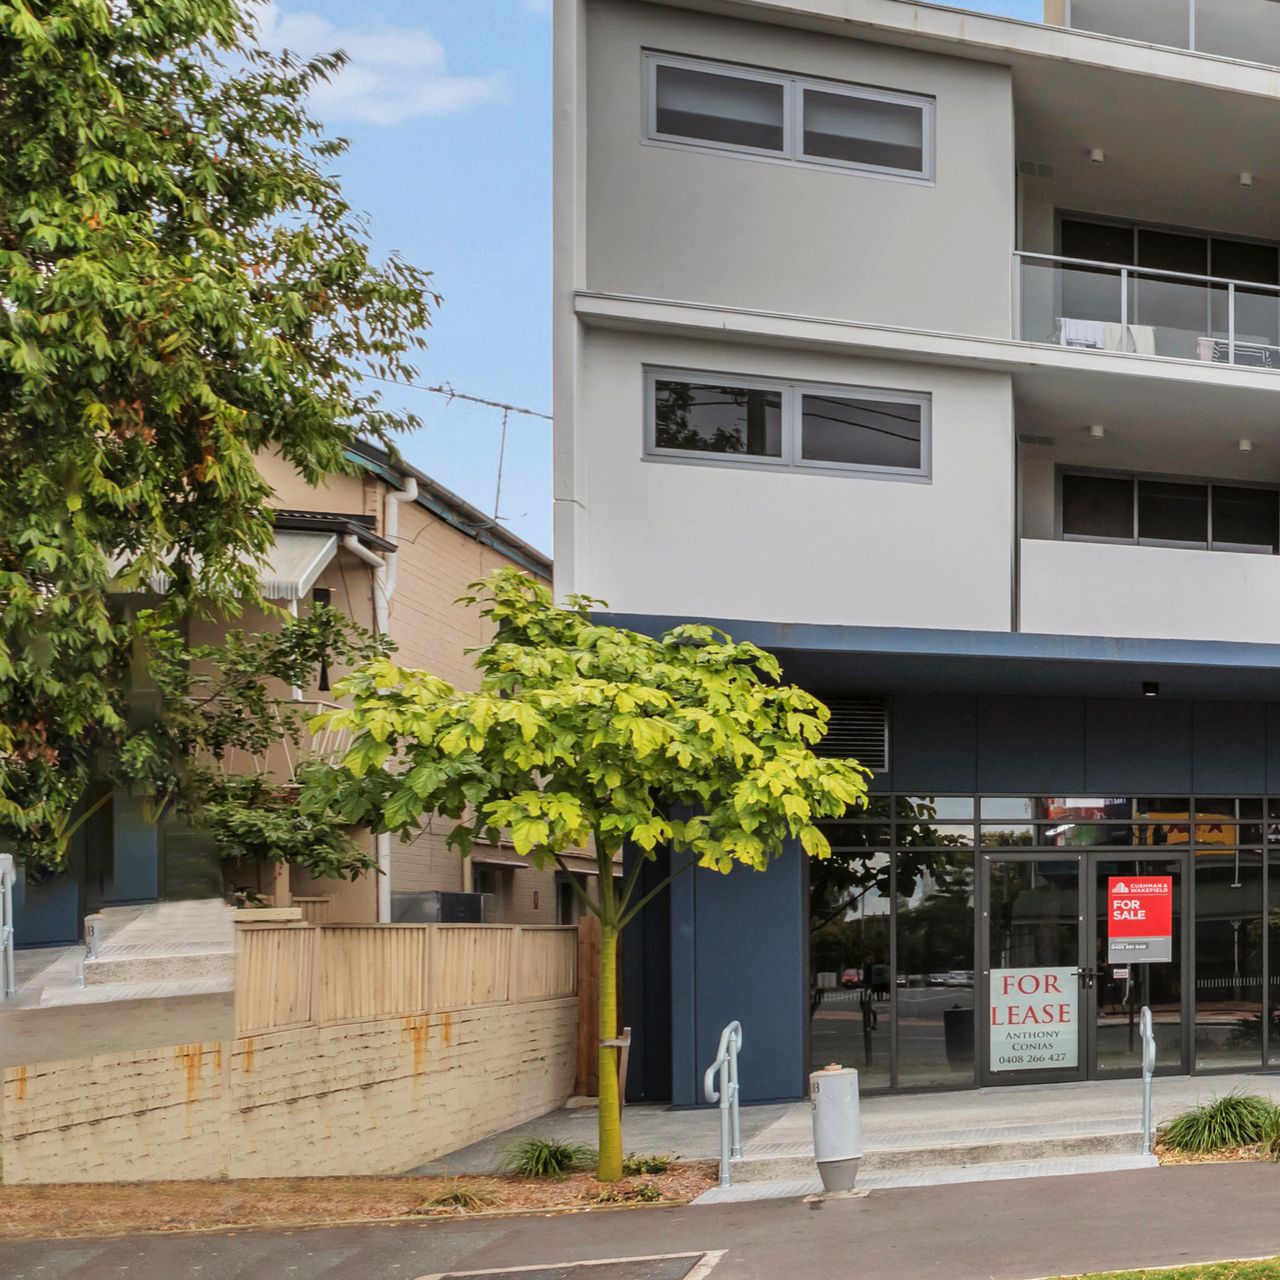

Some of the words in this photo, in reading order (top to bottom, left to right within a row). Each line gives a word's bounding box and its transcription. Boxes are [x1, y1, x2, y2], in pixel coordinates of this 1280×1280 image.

[1113, 900, 1140, 909] FOR
[1113, 910, 1146, 920] SALE
[1002, 974, 1063, 995] FOR
[991, 1003, 1071, 1026] LEASE
[1005, 1030, 1060, 1040] ANTHONY
[1012, 1041, 1054, 1051] CONIAS
[998, 1054, 1024, 1064] 0408
[1027, 1053, 1045, 1063] 266
[1048, 1052, 1067, 1062] 427
